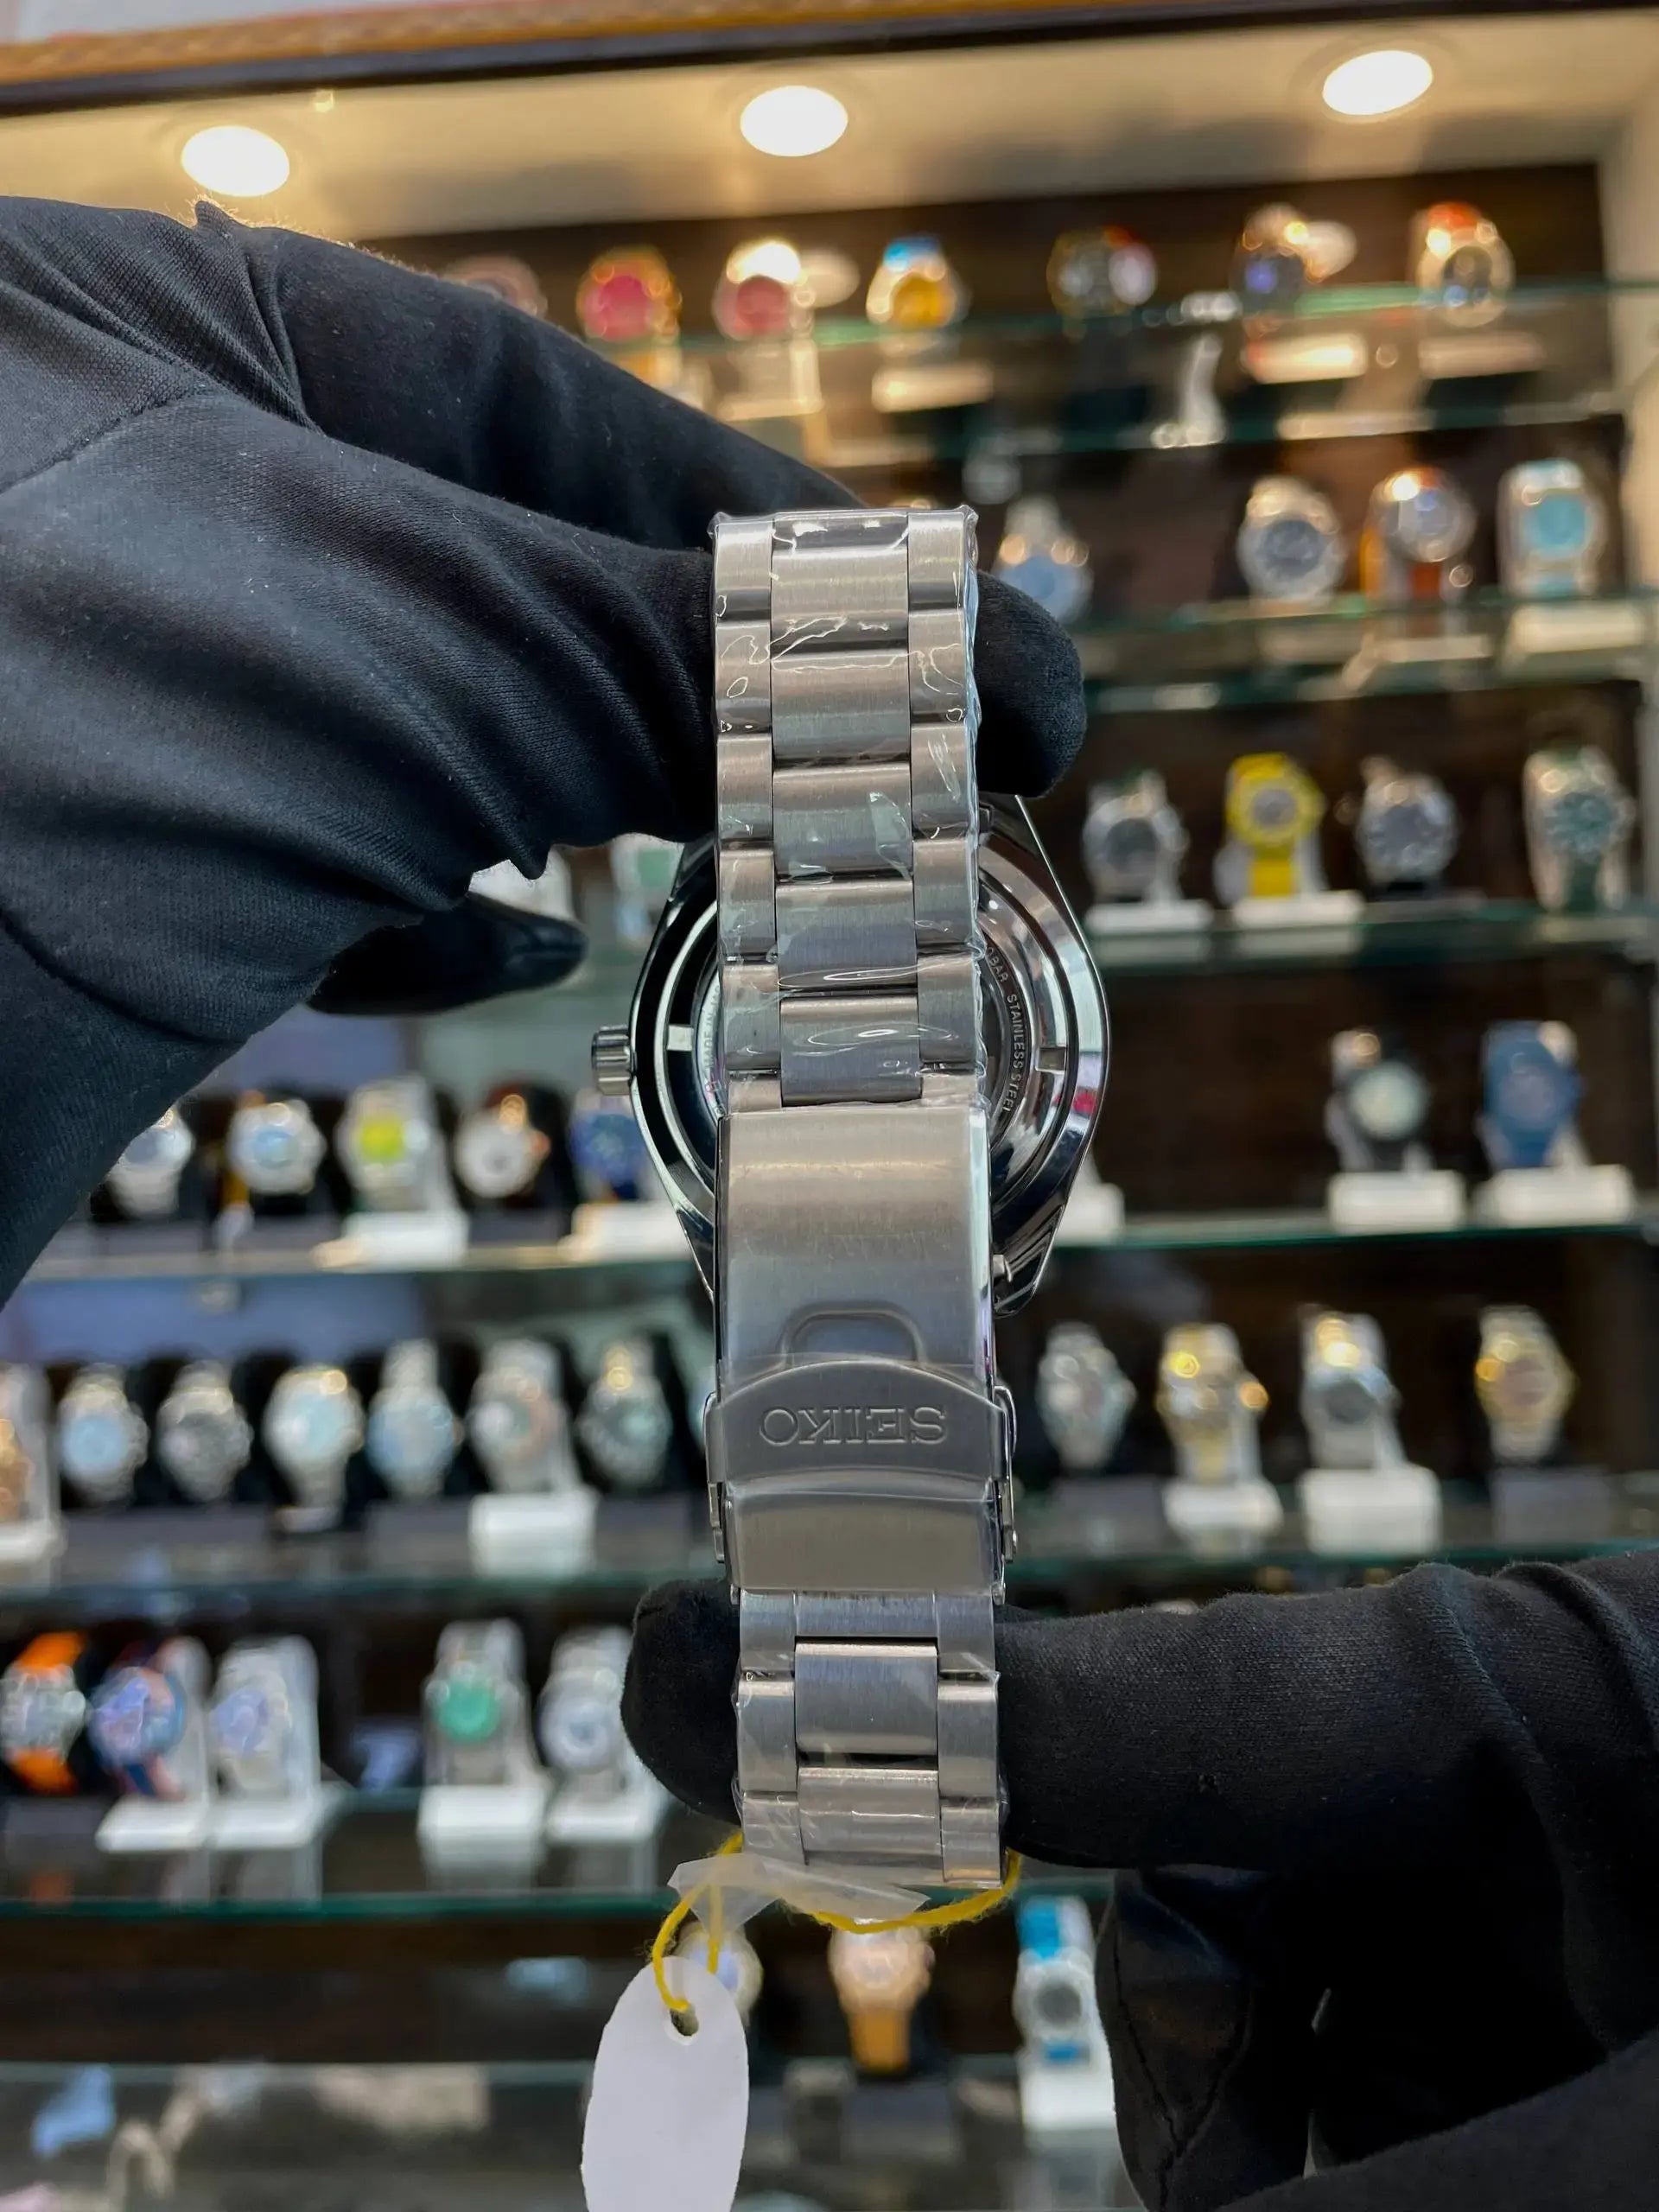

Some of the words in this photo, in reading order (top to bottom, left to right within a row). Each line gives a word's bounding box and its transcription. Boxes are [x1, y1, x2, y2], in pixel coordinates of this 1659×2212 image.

[986, 947, 1008, 982] 0BAR
[1007, 994, 1026, 1068] STAINLESS
[759, 1406, 947, 1446] SEIKO
